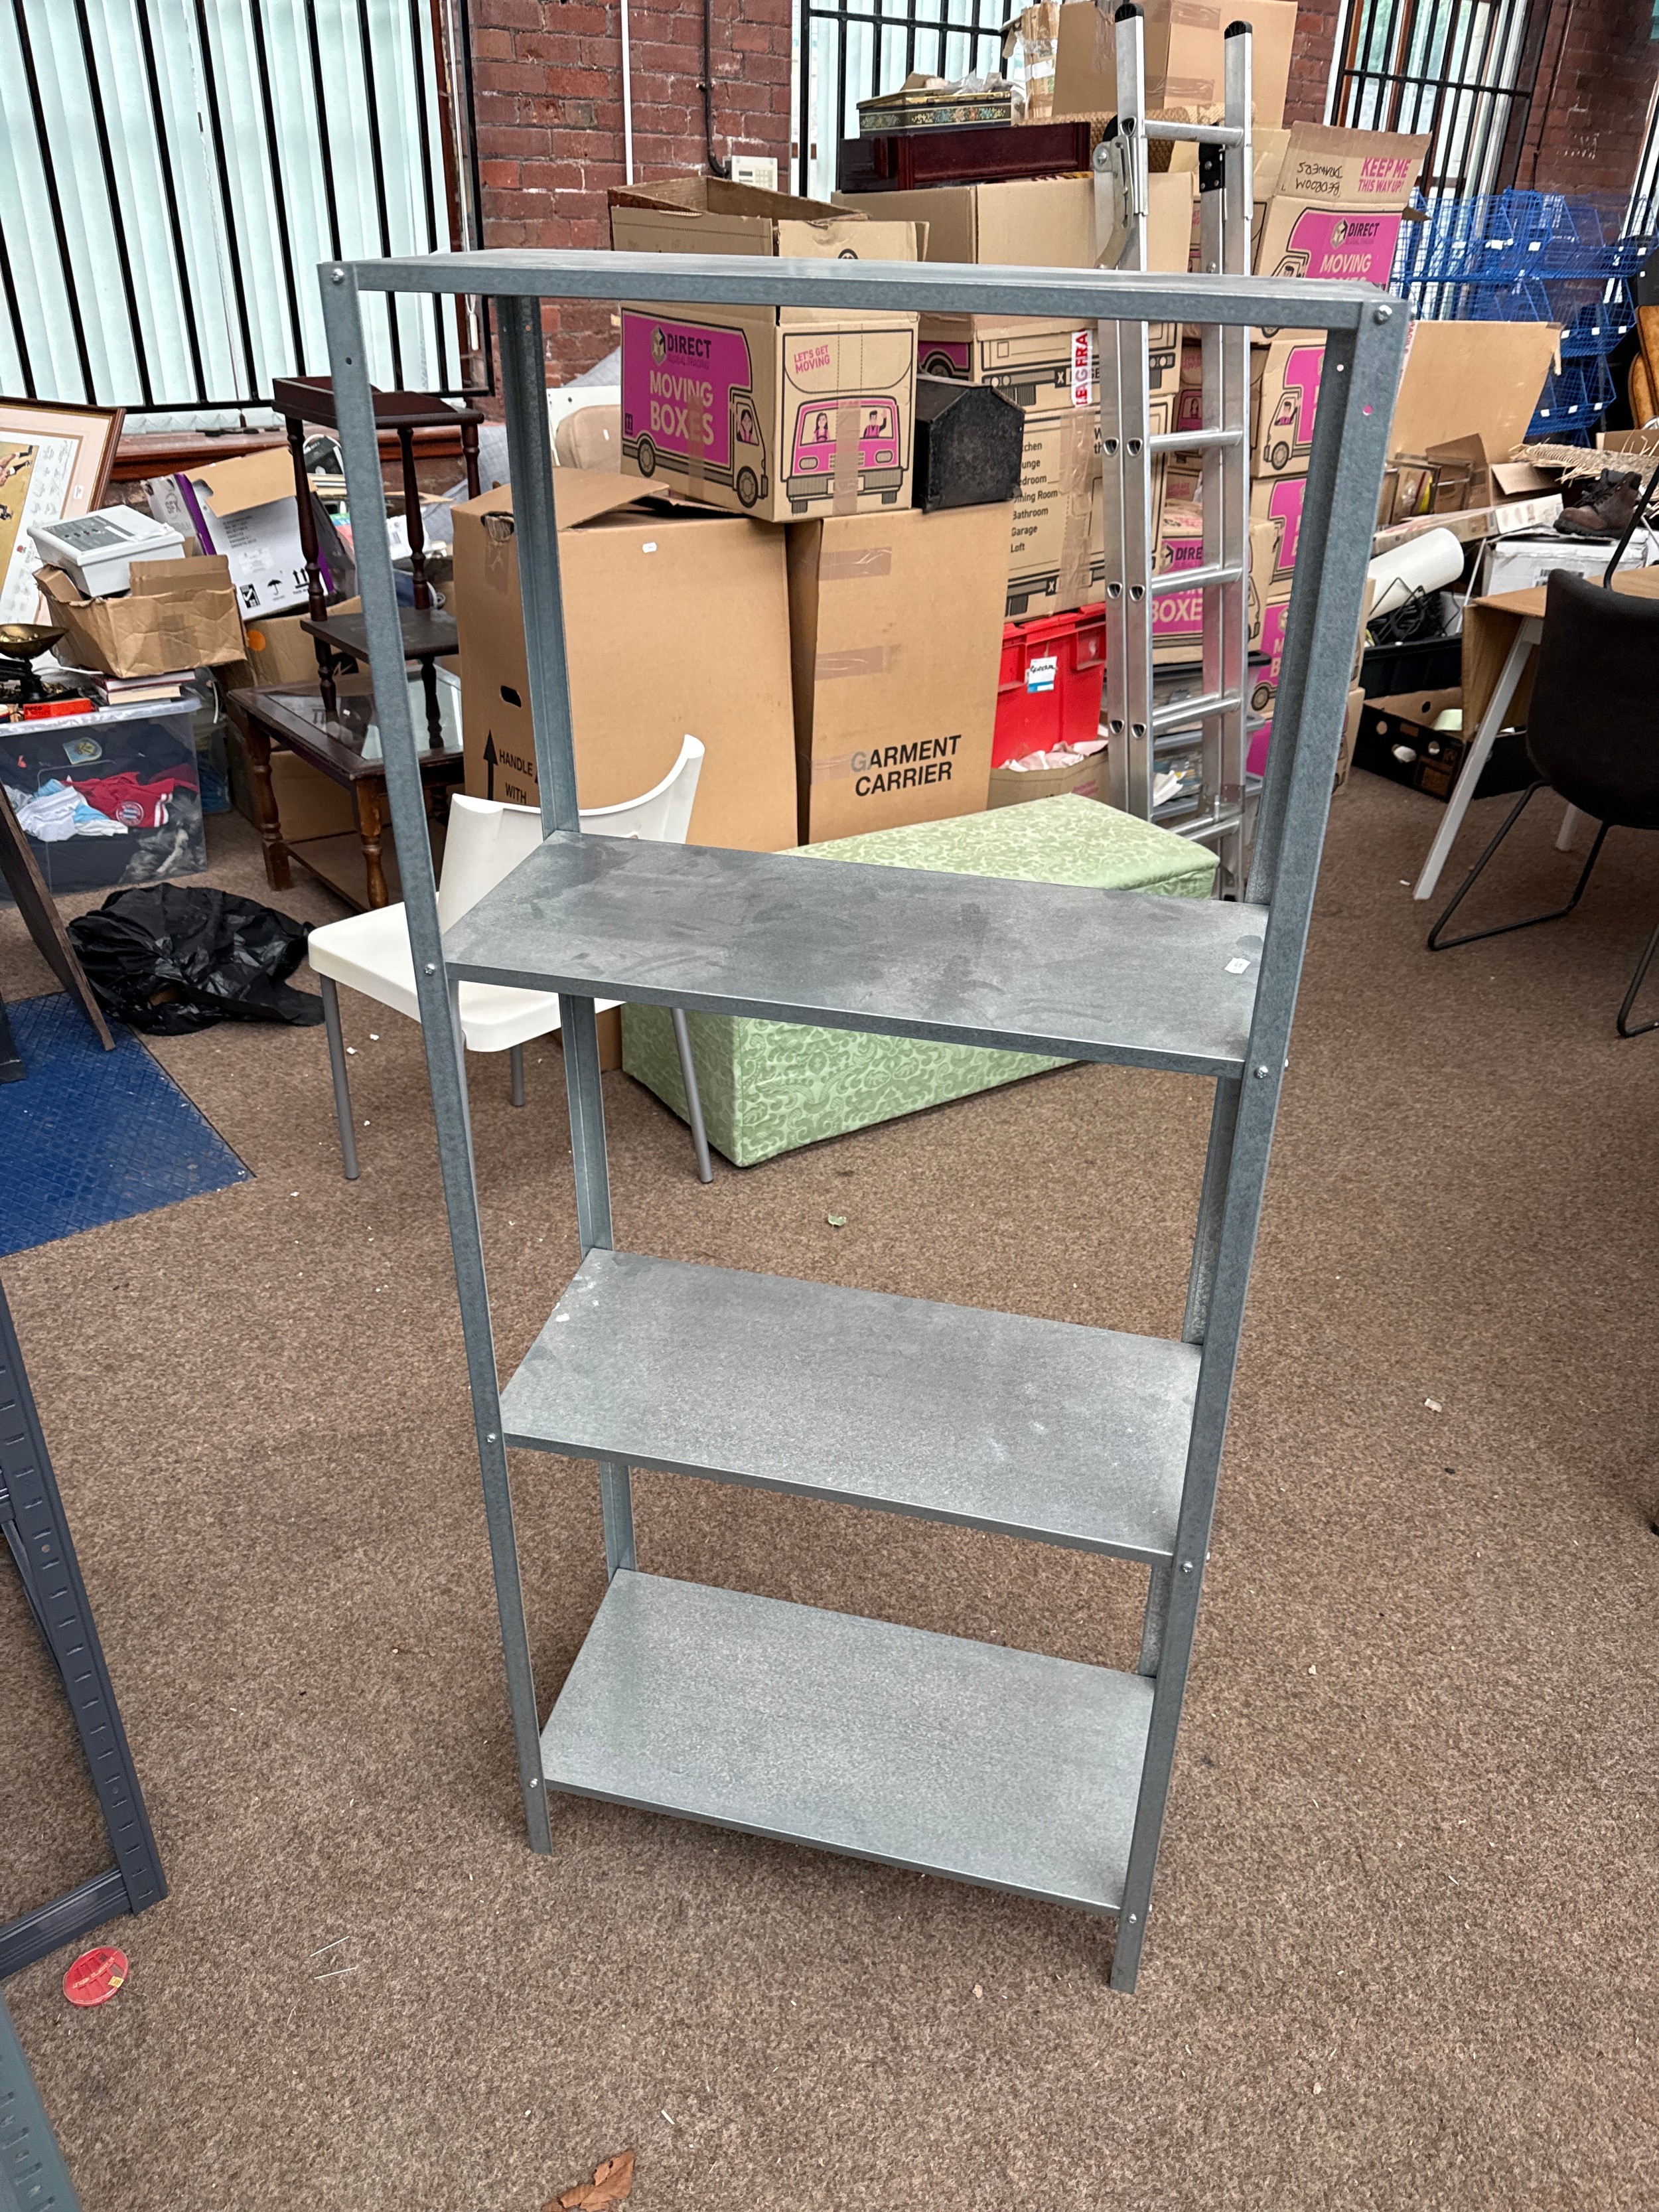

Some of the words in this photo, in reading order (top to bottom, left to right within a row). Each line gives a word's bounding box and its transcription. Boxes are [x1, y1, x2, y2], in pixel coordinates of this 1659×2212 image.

[1361, 157, 1393, 177] KEEP
[1392, 159, 1412, 178] ME
[1295, 178, 1340, 196] BEDROOM
[1358, 179, 1375, 192] THIS
[1376, 179, 1393, 193] WAY
[1391, 180, 1404, 193] UP!
[1348, 223, 1380, 237] DIRECT
[1319, 254, 1372, 273] MOVING
[667, 334, 711, 358] DIRECT
[794, 349, 814, 363] LET'S
[816, 344, 829, 356] GET
[796, 354, 830, 374] MOVING
[650, 370, 713, 407] MOVING
[1022, 459, 1041, 470] unge
[1019, 475, 1046, 486] edroom
[1037, 490, 1058, 500] Room
[1011, 525, 1038, 537] Garage
[1011, 543, 1025, 553] Loft
[1175, 546, 1203, 561] DIRE
[1152, 598, 1202, 623] BOXE
[499, 749, 533, 777] HANDLE
[851, 734, 962, 773] GARMENT
[855, 761, 952, 796] CARRIER
[505, 782, 526, 804] WITH
